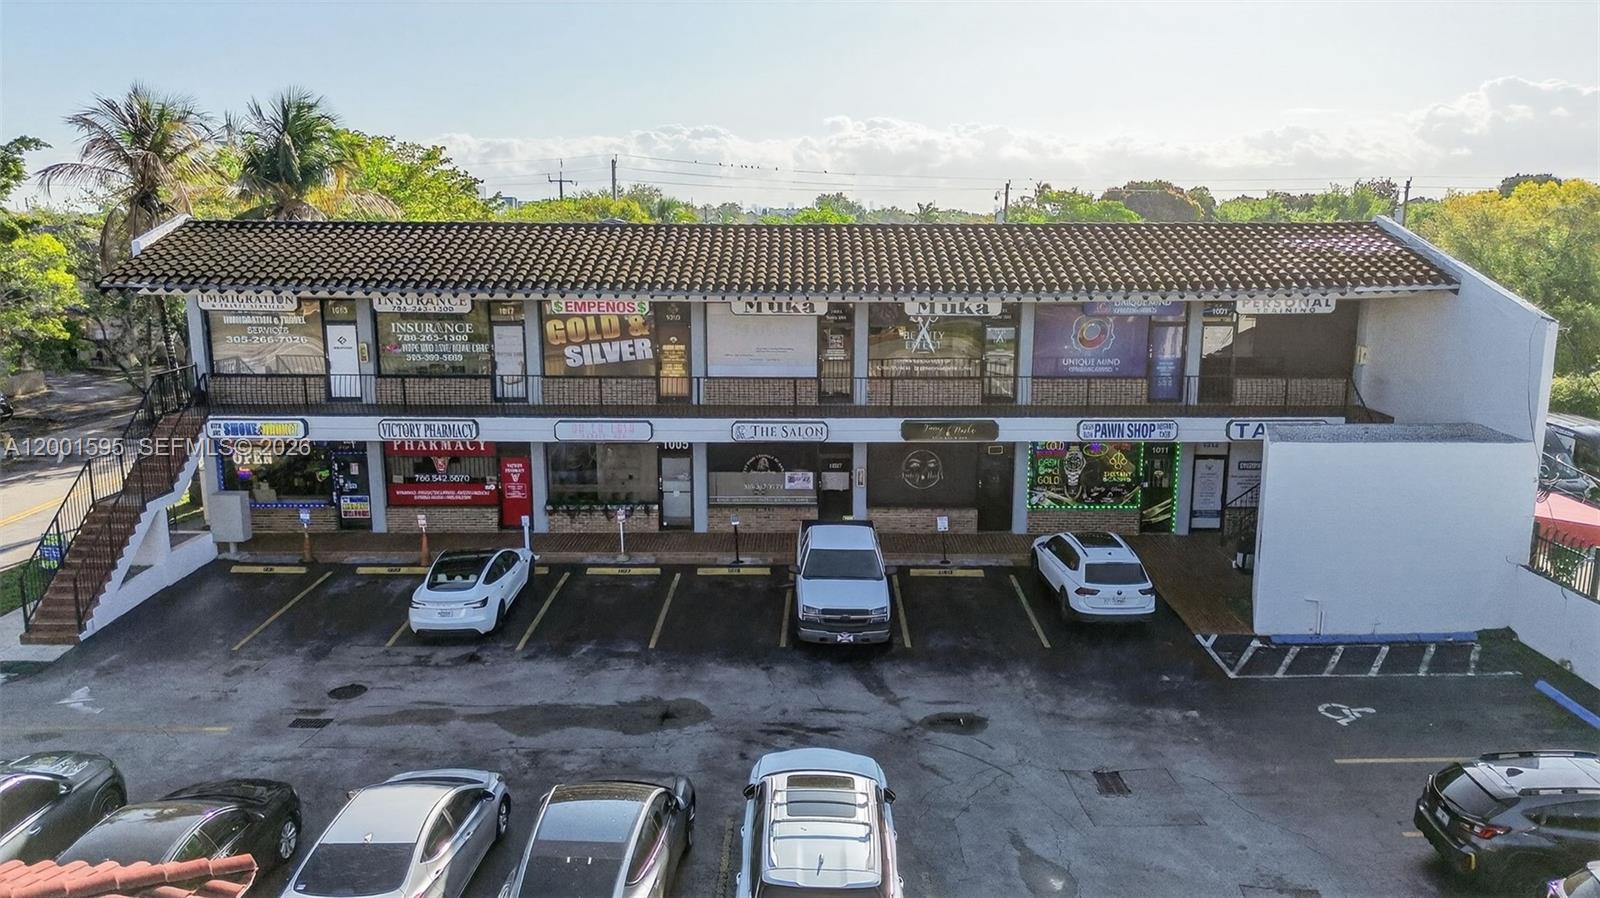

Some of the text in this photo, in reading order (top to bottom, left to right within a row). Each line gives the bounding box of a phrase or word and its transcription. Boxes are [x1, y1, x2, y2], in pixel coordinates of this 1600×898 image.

[201, 295, 294, 304] IMMIGRATION
[377, 297, 468, 306] INSURANCE
[1242, 299, 1332, 308] PERSONAL
[391, 322, 474, 333] INSURANCE
[546, 314, 650, 345] GOLD &
[564, 337, 653, 368] SILVER
[223, 423, 257, 436] SMOKE
[381, 423, 475, 438] VICTORY PHARMACY
[750, 425, 777, 438] THE
[1094, 423, 1156, 439] PAWN SHOP
[393, 440, 486, 451] PHARMACY
[1037, 476, 1060, 485] GOLD
